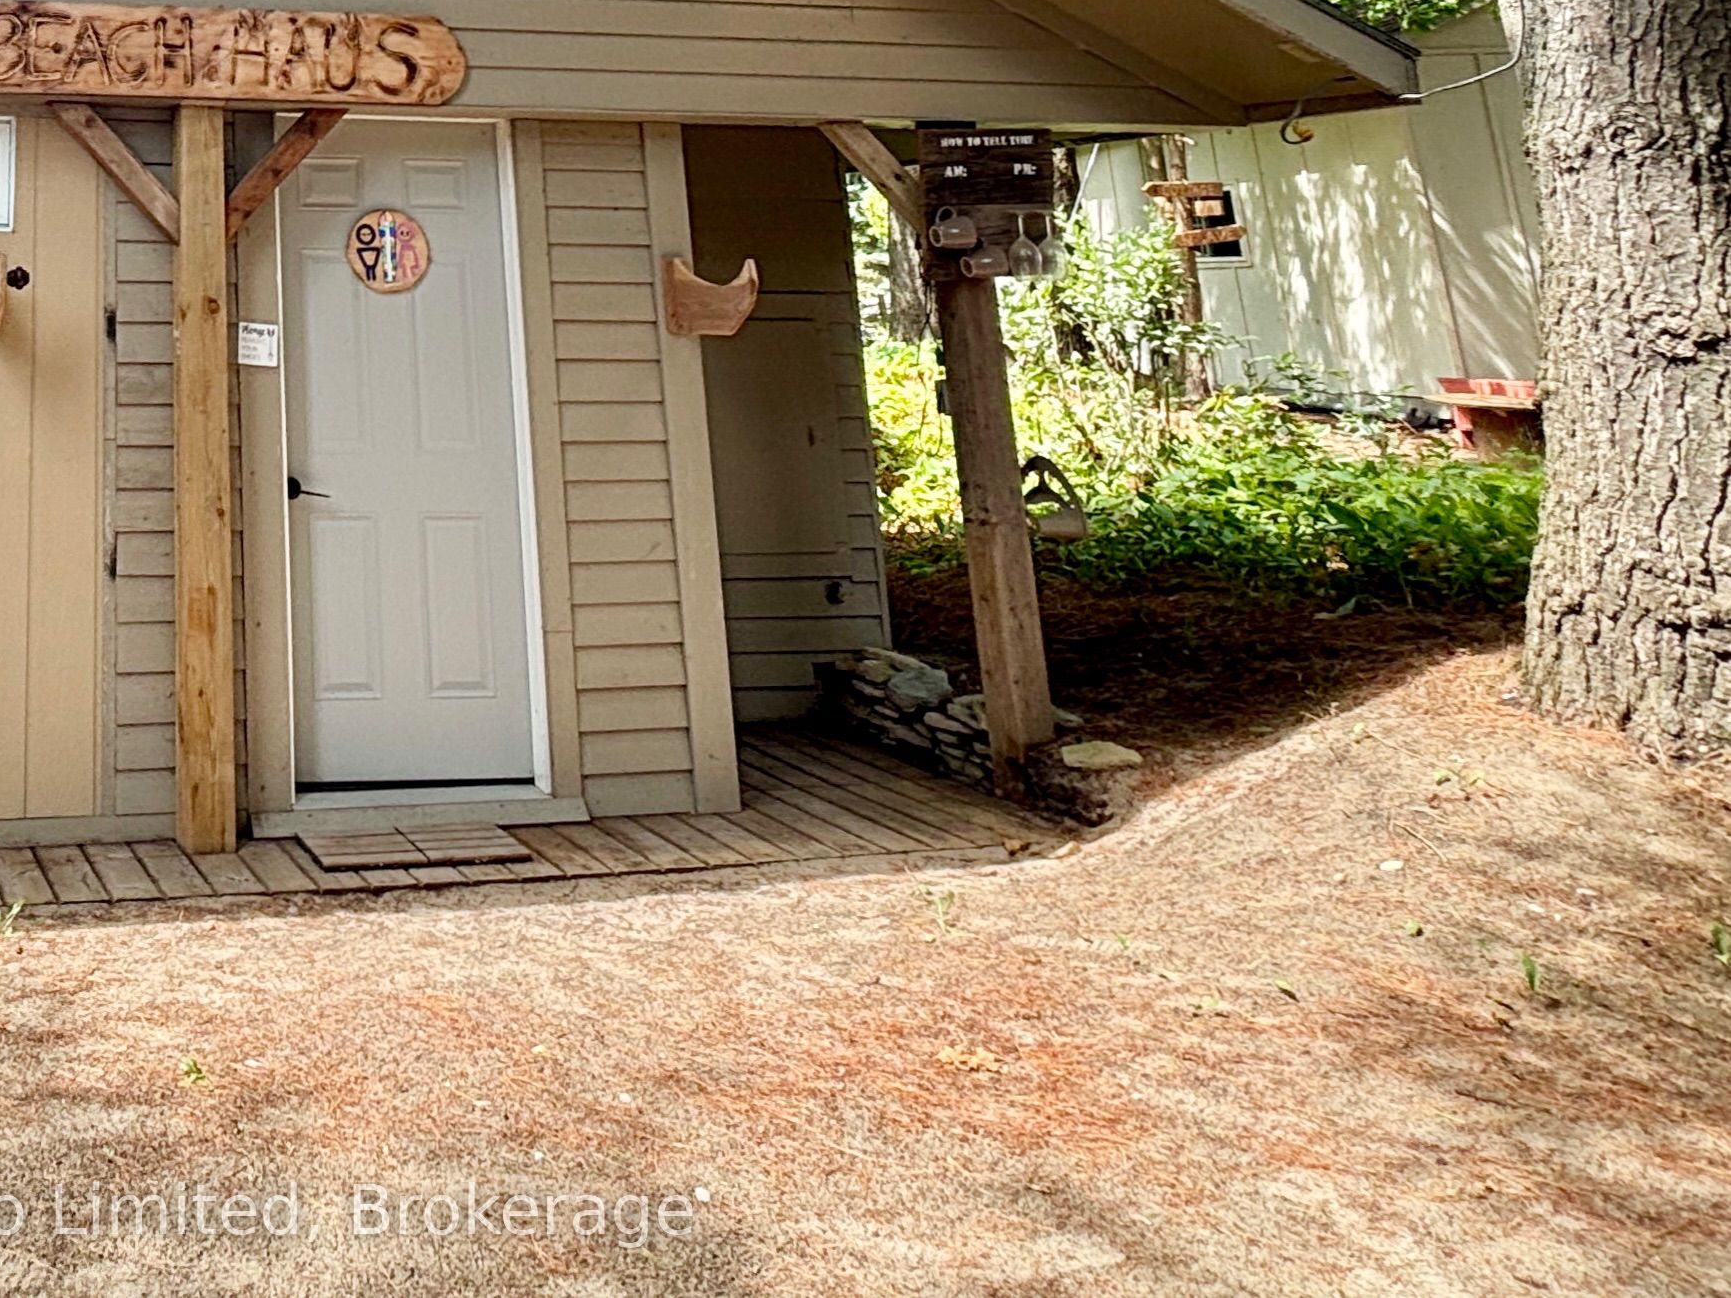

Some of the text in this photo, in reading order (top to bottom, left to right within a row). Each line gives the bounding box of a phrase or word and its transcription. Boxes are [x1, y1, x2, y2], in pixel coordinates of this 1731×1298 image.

[227, 13, 426, 96] HAUS
[940, 136, 963, 148] HOW
[966, 136, 982, 147] TO
[982, 135, 1007, 147] TELL
[944, 165, 968, 178] AM:
